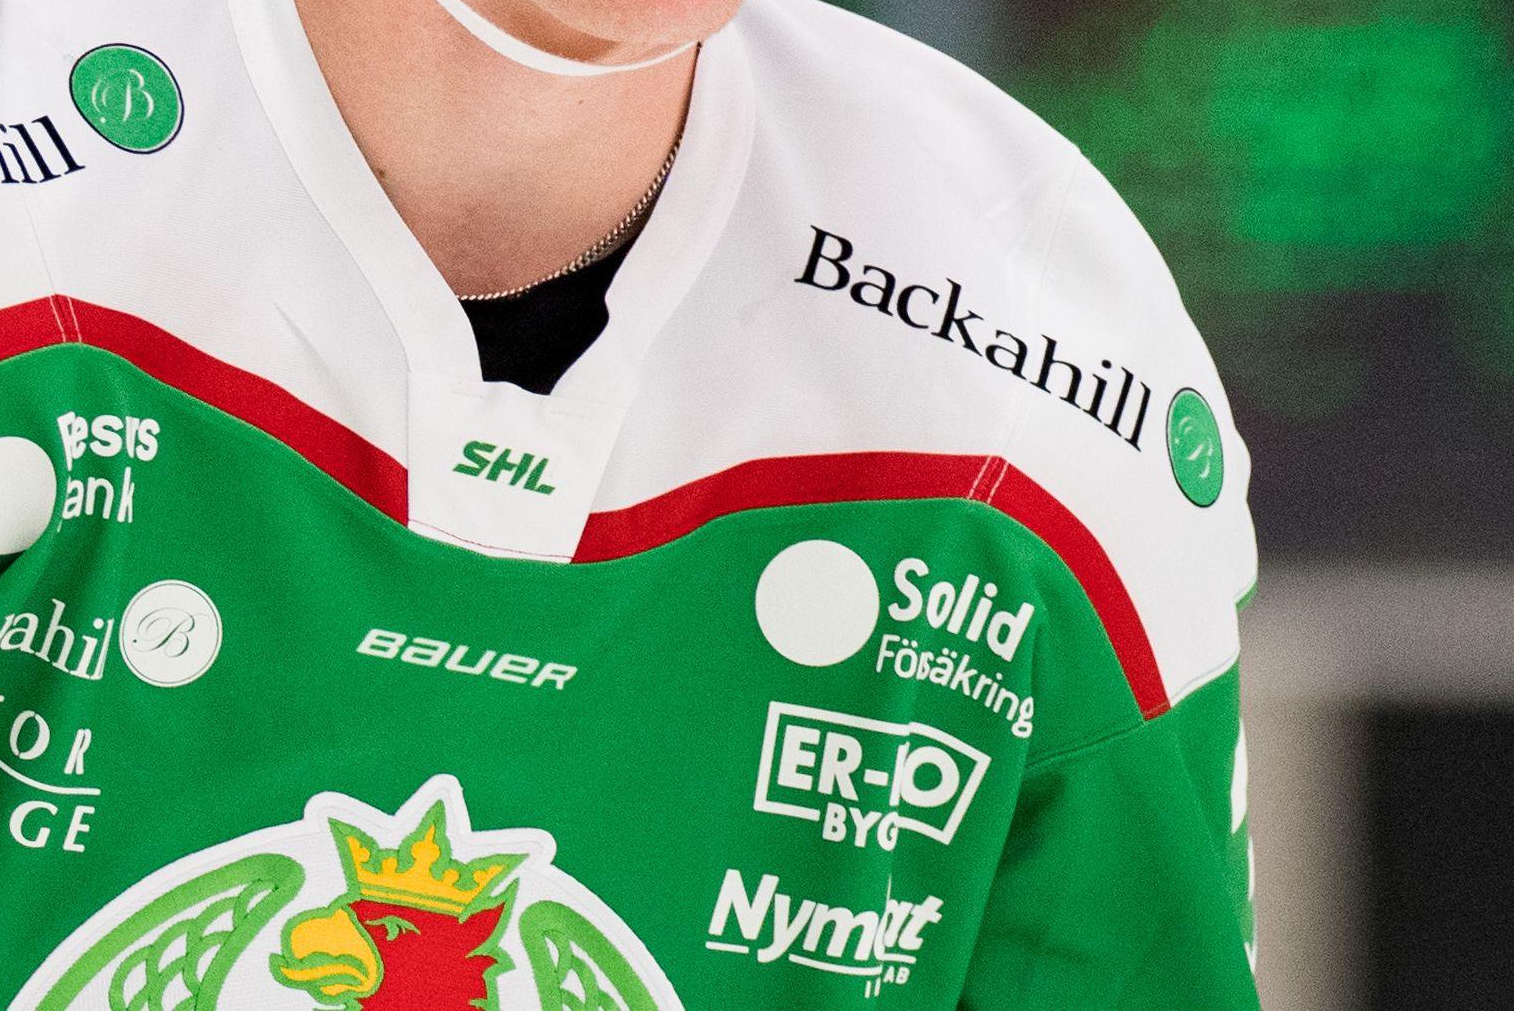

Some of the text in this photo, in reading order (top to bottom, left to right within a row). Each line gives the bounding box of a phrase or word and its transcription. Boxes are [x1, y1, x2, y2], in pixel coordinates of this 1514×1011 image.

[794, 225, 1152, 453] Backahill
[56, 466, 136, 533] ank
[452, 440, 556, 496] SHL
[887, 557, 1035, 662] Solid
[355, 627, 579, 691] BAUER
